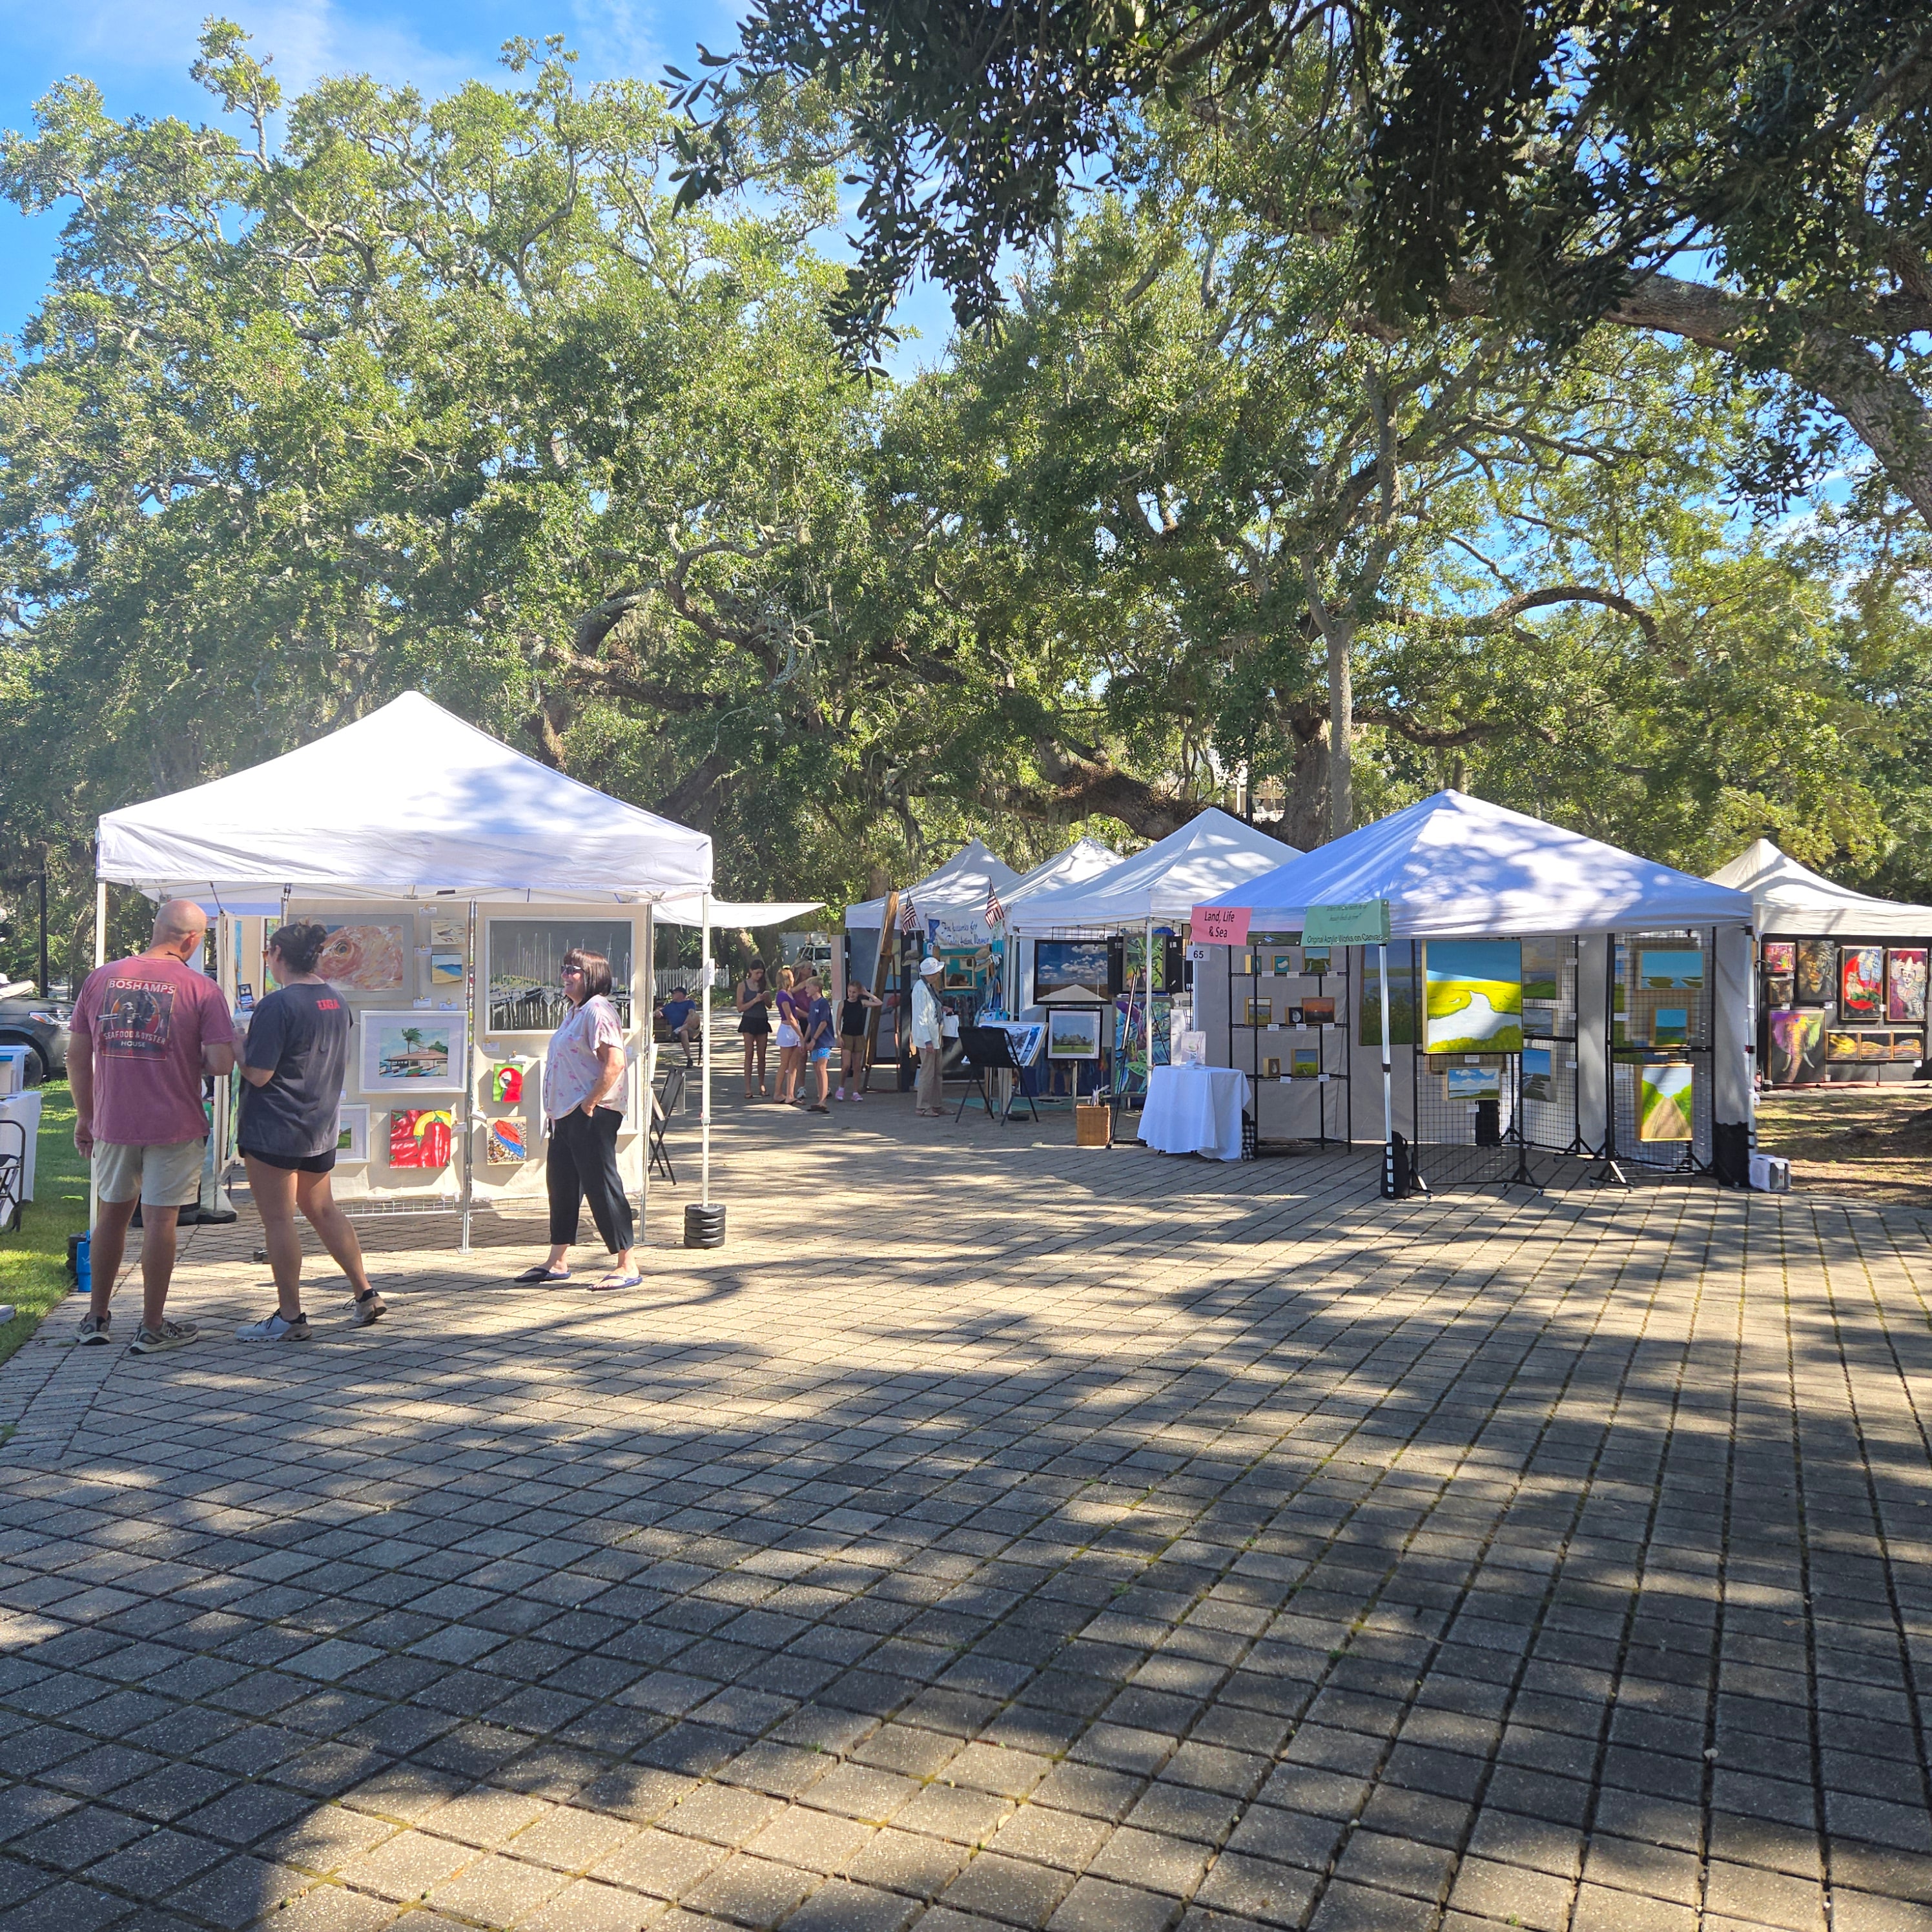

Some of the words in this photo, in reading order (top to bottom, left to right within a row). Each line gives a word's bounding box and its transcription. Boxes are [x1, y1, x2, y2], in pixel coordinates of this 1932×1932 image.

[1204, 910, 1221, 924] Land,
[1222, 910, 1235, 923] Life
[1208, 925, 1214, 937] &
[1215, 926, 1228, 938] Sea
[1307, 935, 1323, 945] Original
[1338, 934, 1353, 943] Works
[1362, 933, 1383, 941] Canvas
[1193, 950, 1204, 959] 65
[108, 980, 175, 994] BOSHAMPS
[103, 1031, 134, 1040] SEAFOOD
[141, 1032, 166, 1045] OYSTER
